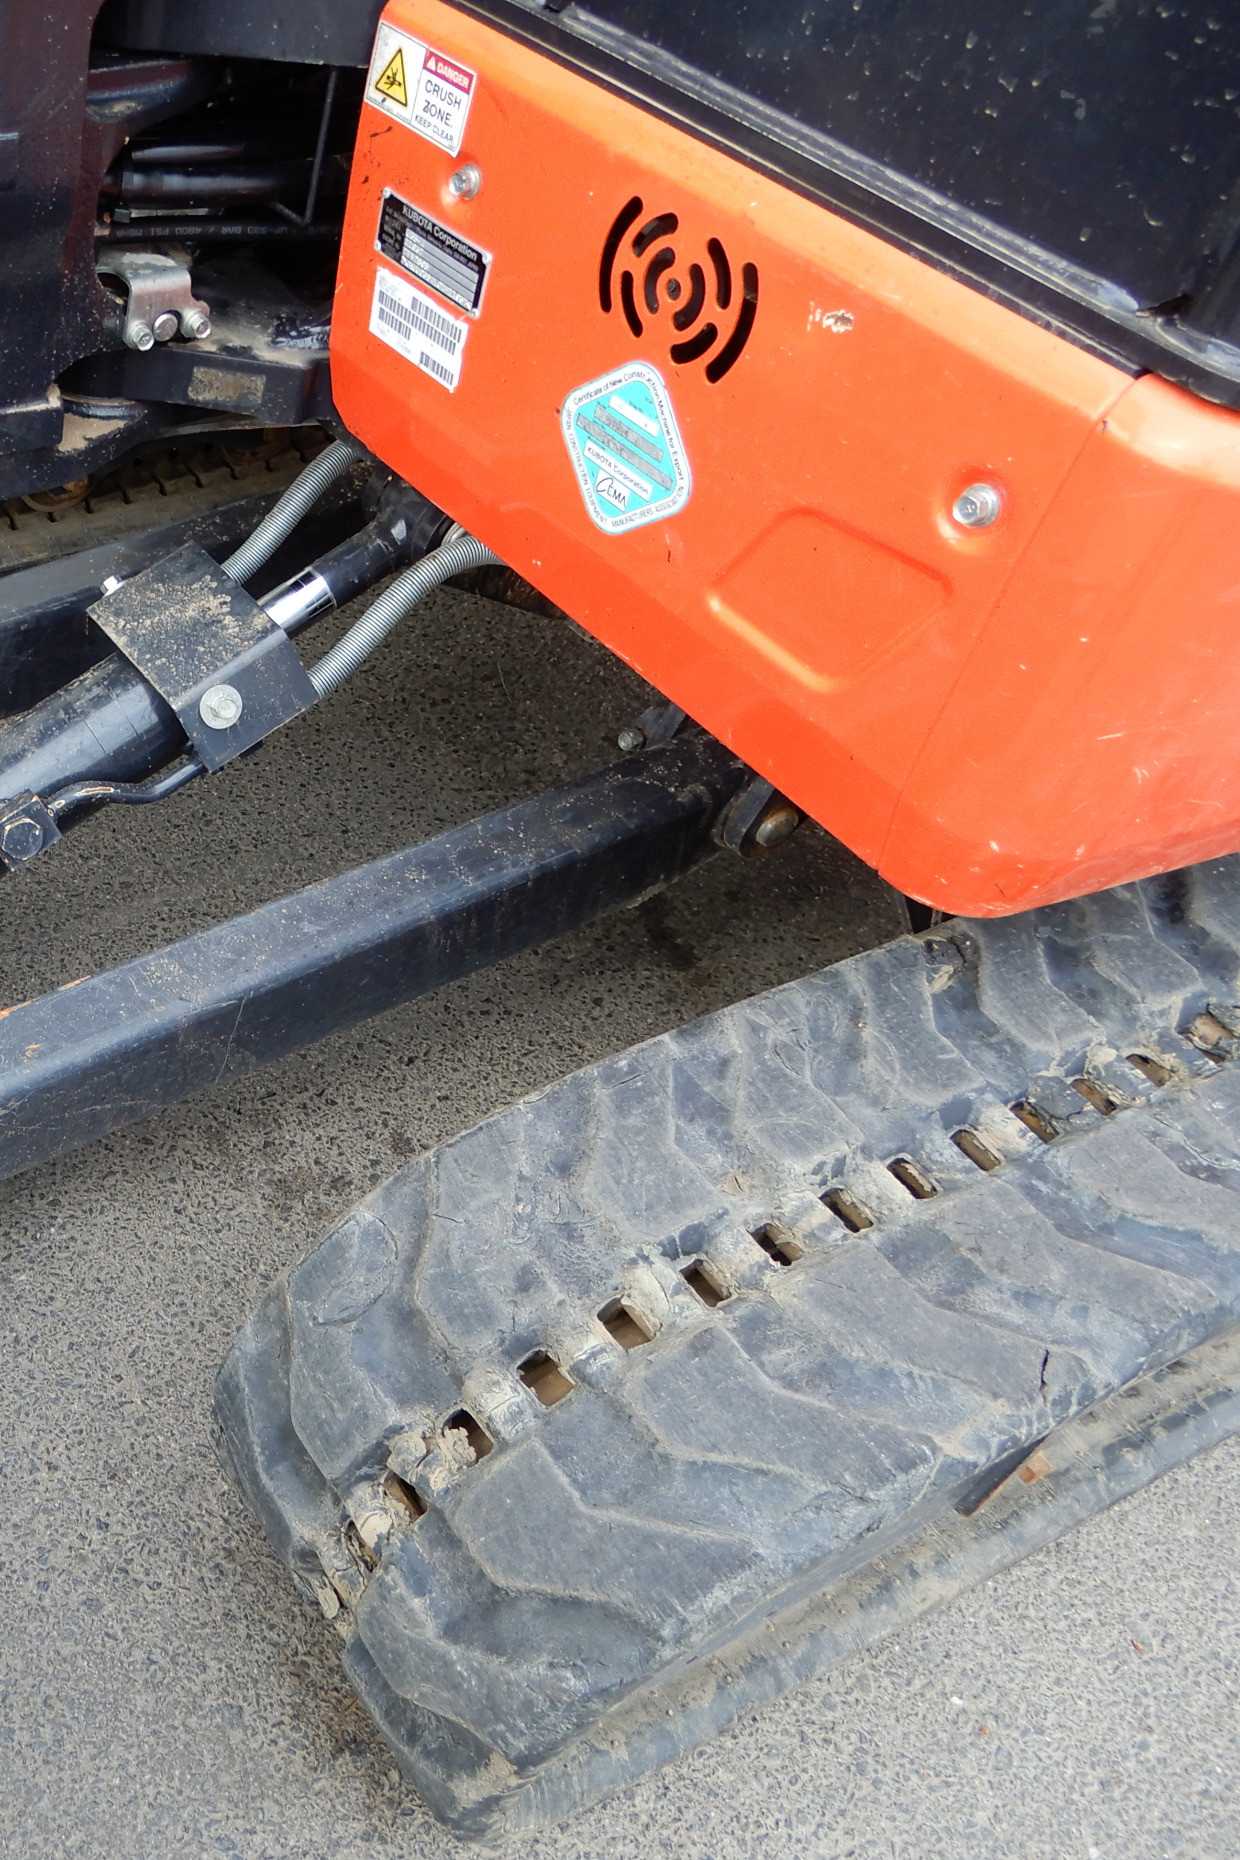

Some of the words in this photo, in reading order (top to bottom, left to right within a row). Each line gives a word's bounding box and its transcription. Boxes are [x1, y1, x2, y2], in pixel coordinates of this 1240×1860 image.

[437, 62, 470, 89] DANGER
[425, 79, 462, 111] CRUSH
[415, 114, 432, 129] KEEP
[151, 227, 170, 236] PSI
[221, 226, 242, 235] BAR
[402, 205, 433, 233] KUBOTA
[433, 226, 478, 262] Corporation
[573, 384, 603, 405] Certificate
[609, 378, 623, 387] New
[658, 400, 671, 437] Machine
[672, 450, 684, 481] Export
[587, 446, 612, 468] KUBOTA
[613, 464, 649, 495] Corporation
[611, 506, 654, 528] MANUFACTURERS
[654, 486, 685, 513] ASSOCIATION
